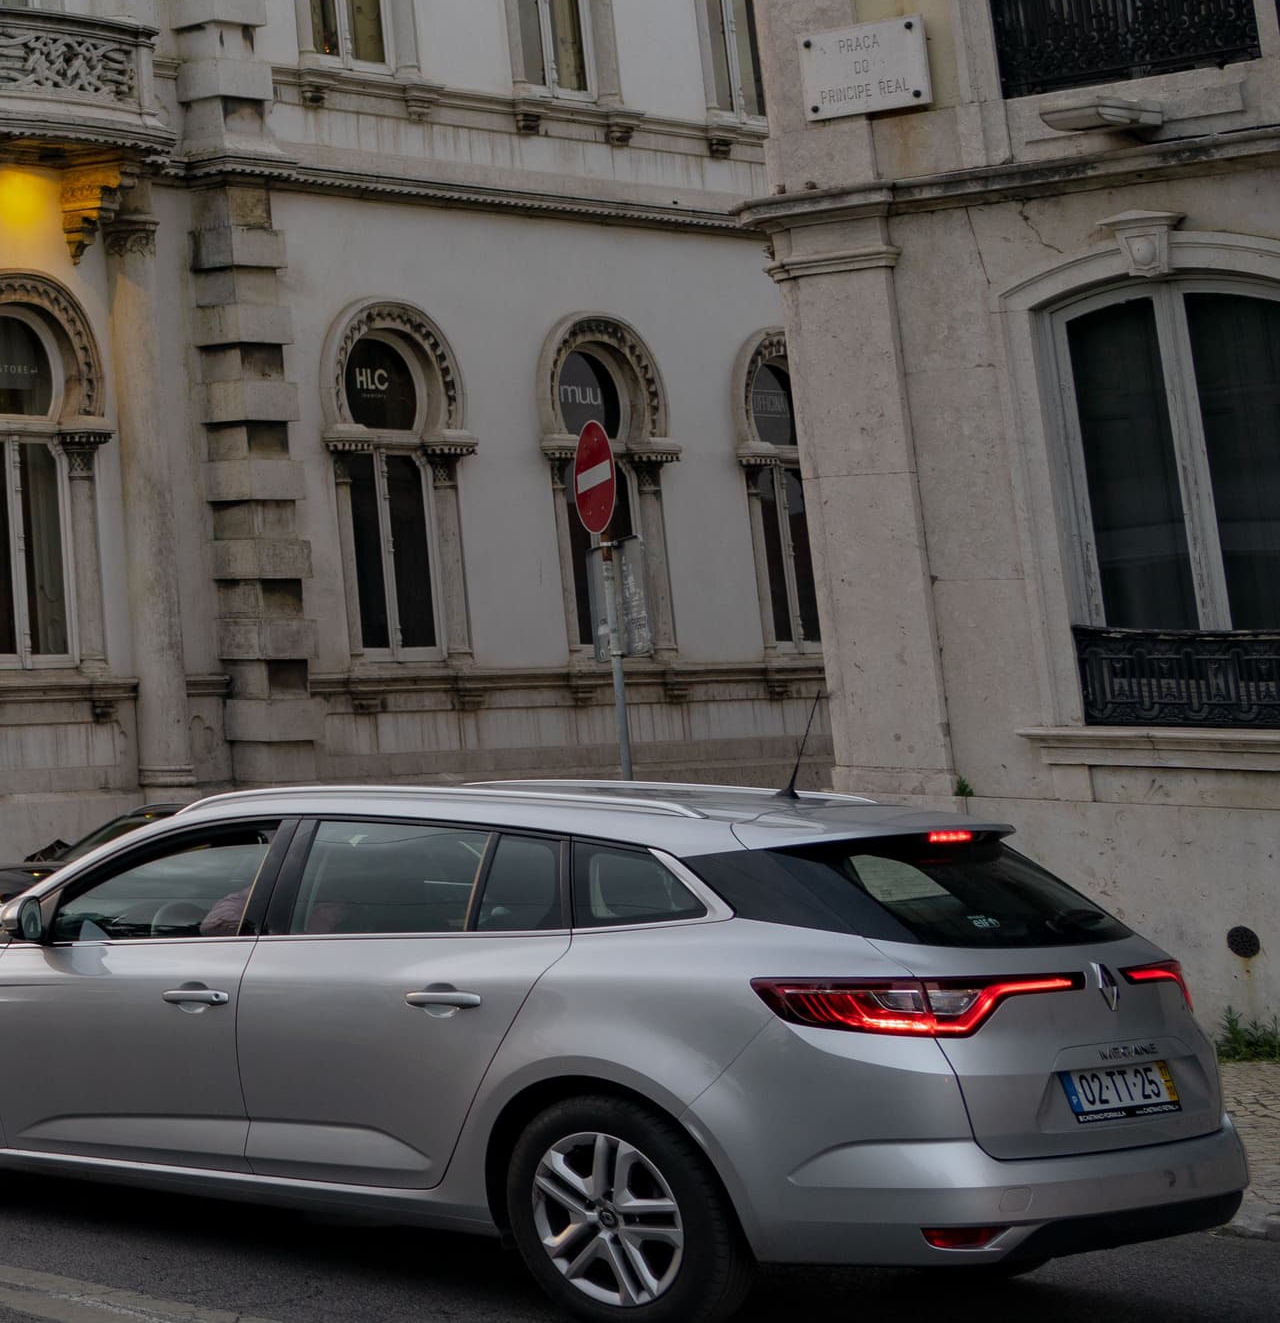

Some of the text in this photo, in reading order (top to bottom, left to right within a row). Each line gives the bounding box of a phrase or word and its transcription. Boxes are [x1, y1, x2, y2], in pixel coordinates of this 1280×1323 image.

[853, 59, 870, 75] DO
[878, 77, 911, 96] REAL
[355, 367, 389, 391] HLC
[559, 384, 602, 405] muu
